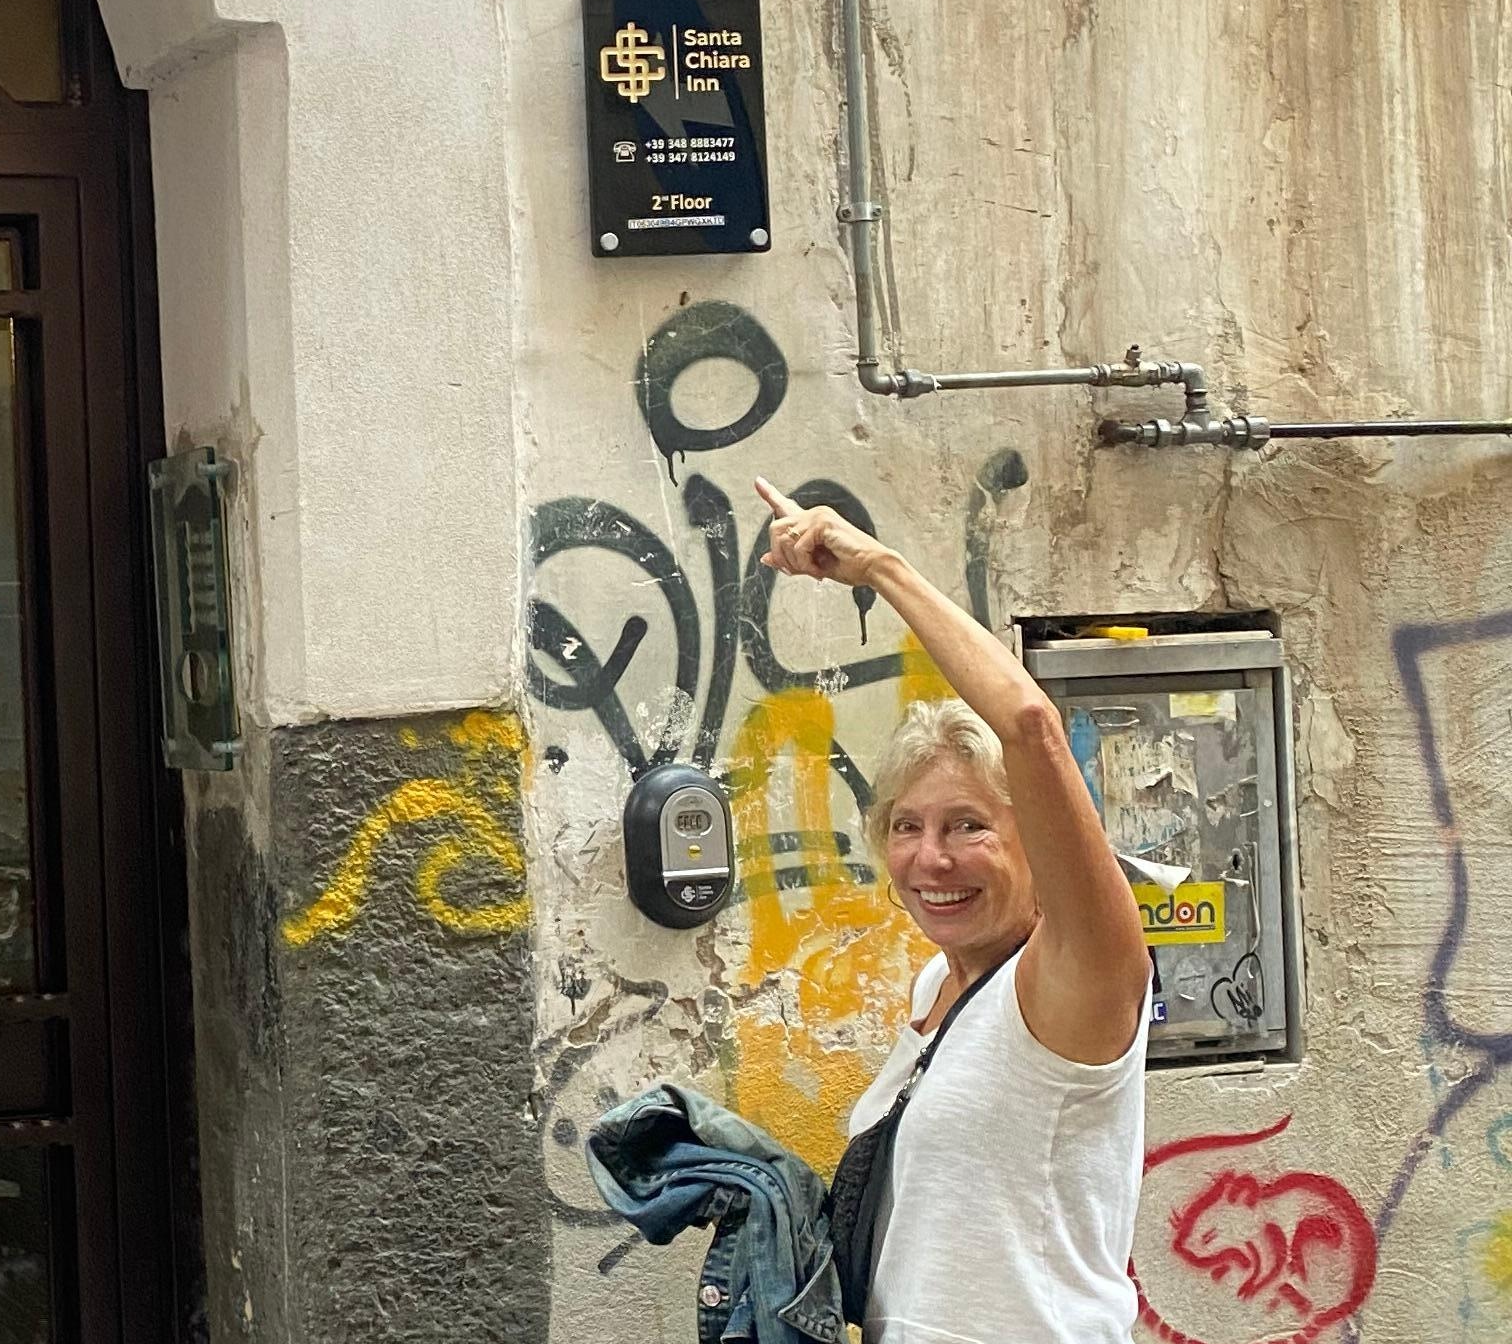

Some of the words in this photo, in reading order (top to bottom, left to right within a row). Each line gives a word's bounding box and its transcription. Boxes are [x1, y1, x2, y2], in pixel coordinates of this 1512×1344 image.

[684, 29, 742, 47] Santa
[685, 52, 751, 69] Chiara
[687, 75, 720, 92] Inn
[645, 139, 665, 150] +39
[668, 138, 688, 149] 348
[645, 153, 665, 163] +39
[668, 152, 688, 163] 347
[691, 151, 736, 162] 8124149
[670, 193, 713, 210] Floor
